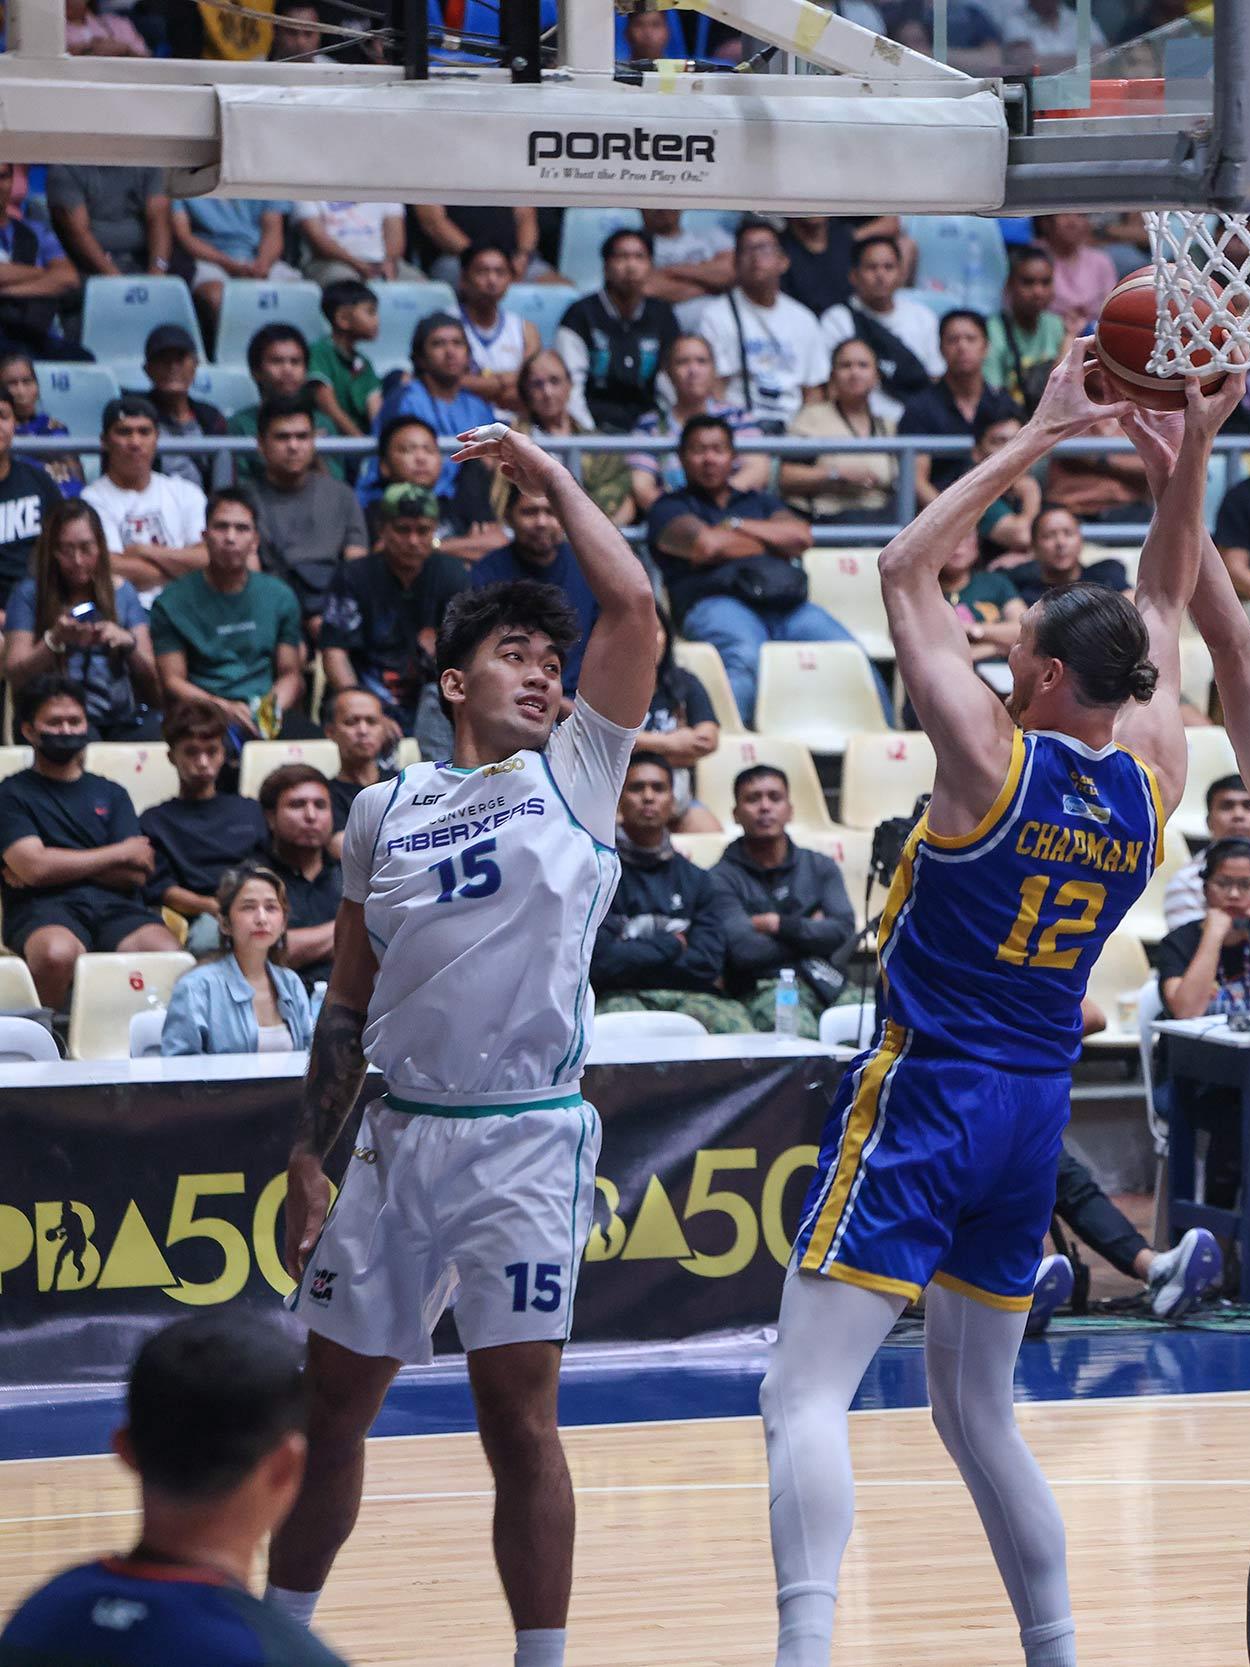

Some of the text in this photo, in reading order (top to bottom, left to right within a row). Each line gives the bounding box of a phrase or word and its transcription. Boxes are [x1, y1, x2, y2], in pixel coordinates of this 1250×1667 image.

[563, 168, 592, 181] What
[597, 169, 615, 180] the
[651, 170, 676, 185] Play
[428, 836, 503, 904] 15
[1015, 820, 1144, 874] CHAPMAN
[995, 874, 1108, 970] 12
[505, 1262, 562, 1313] 15
